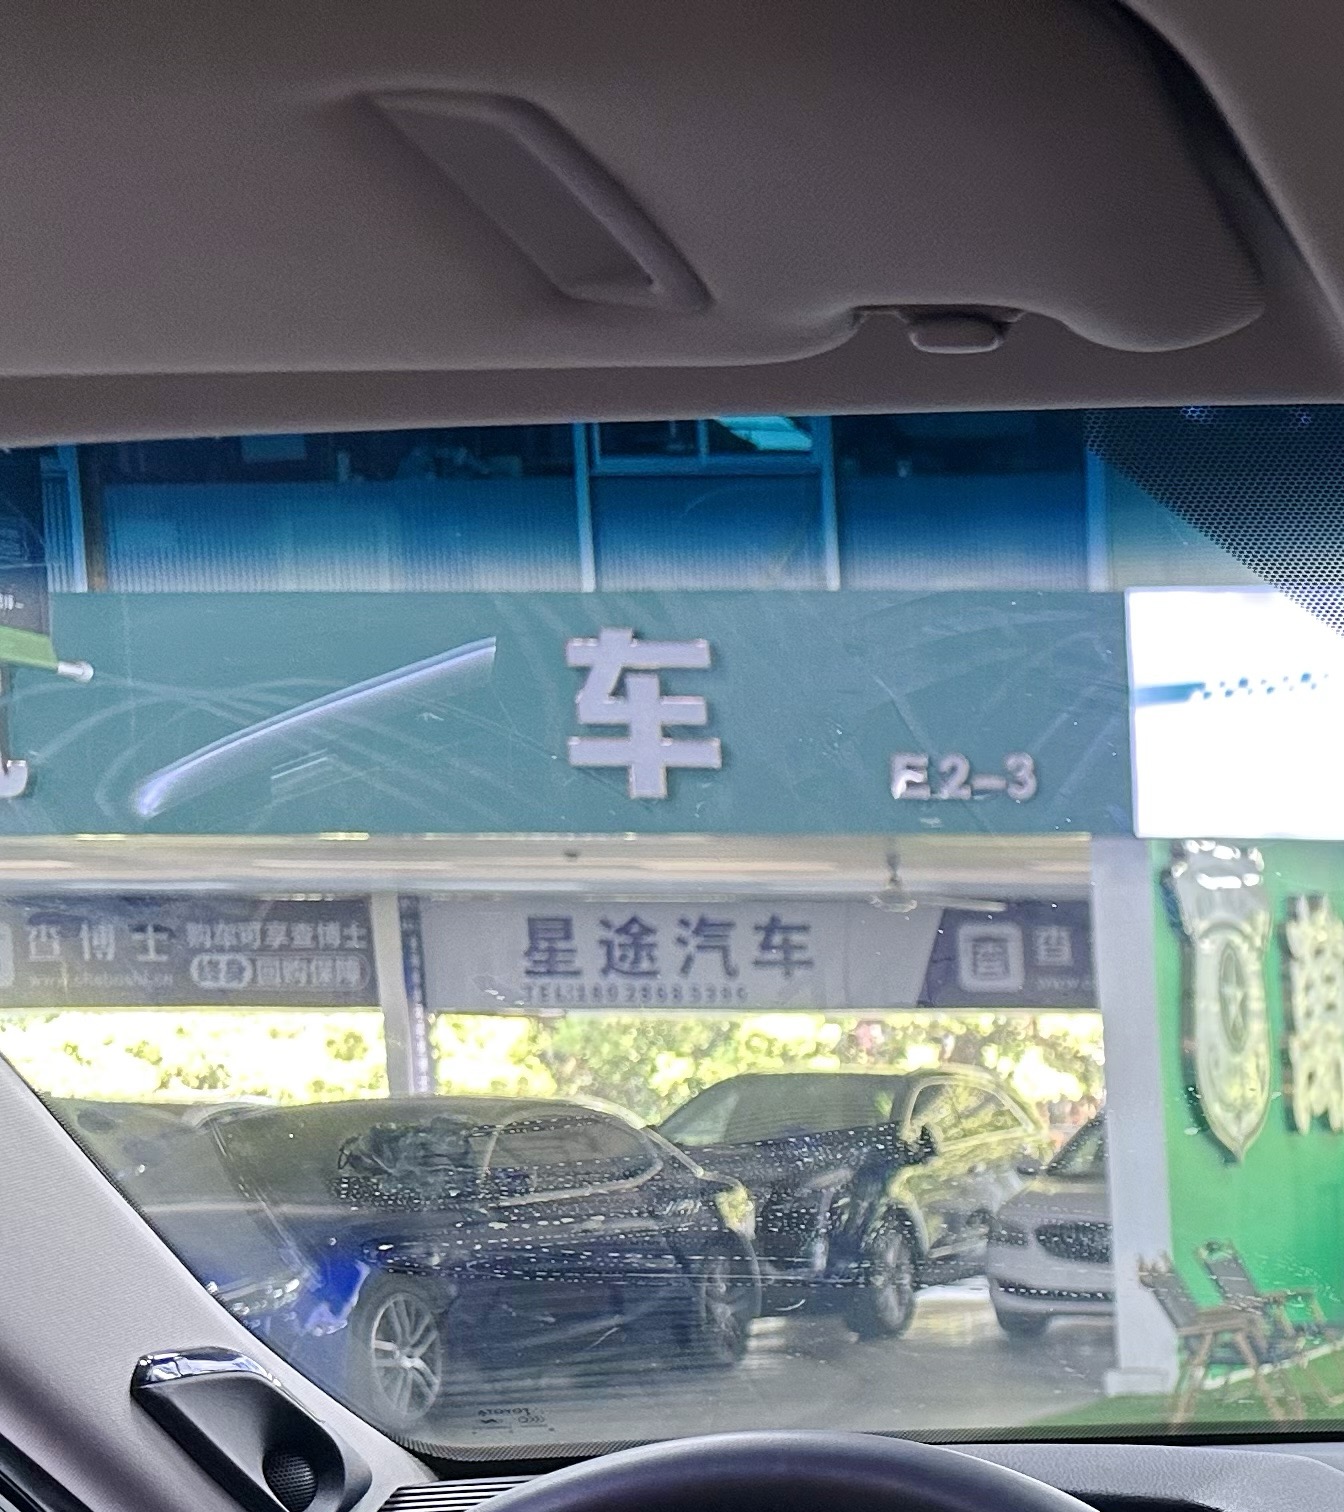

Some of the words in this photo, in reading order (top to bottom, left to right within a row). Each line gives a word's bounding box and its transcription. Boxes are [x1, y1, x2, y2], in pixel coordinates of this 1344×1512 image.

[565, 627, 723, 799] 车
[890, 752, 1038, 801] E2-3
[524, 914, 814, 978] 星途汽车
